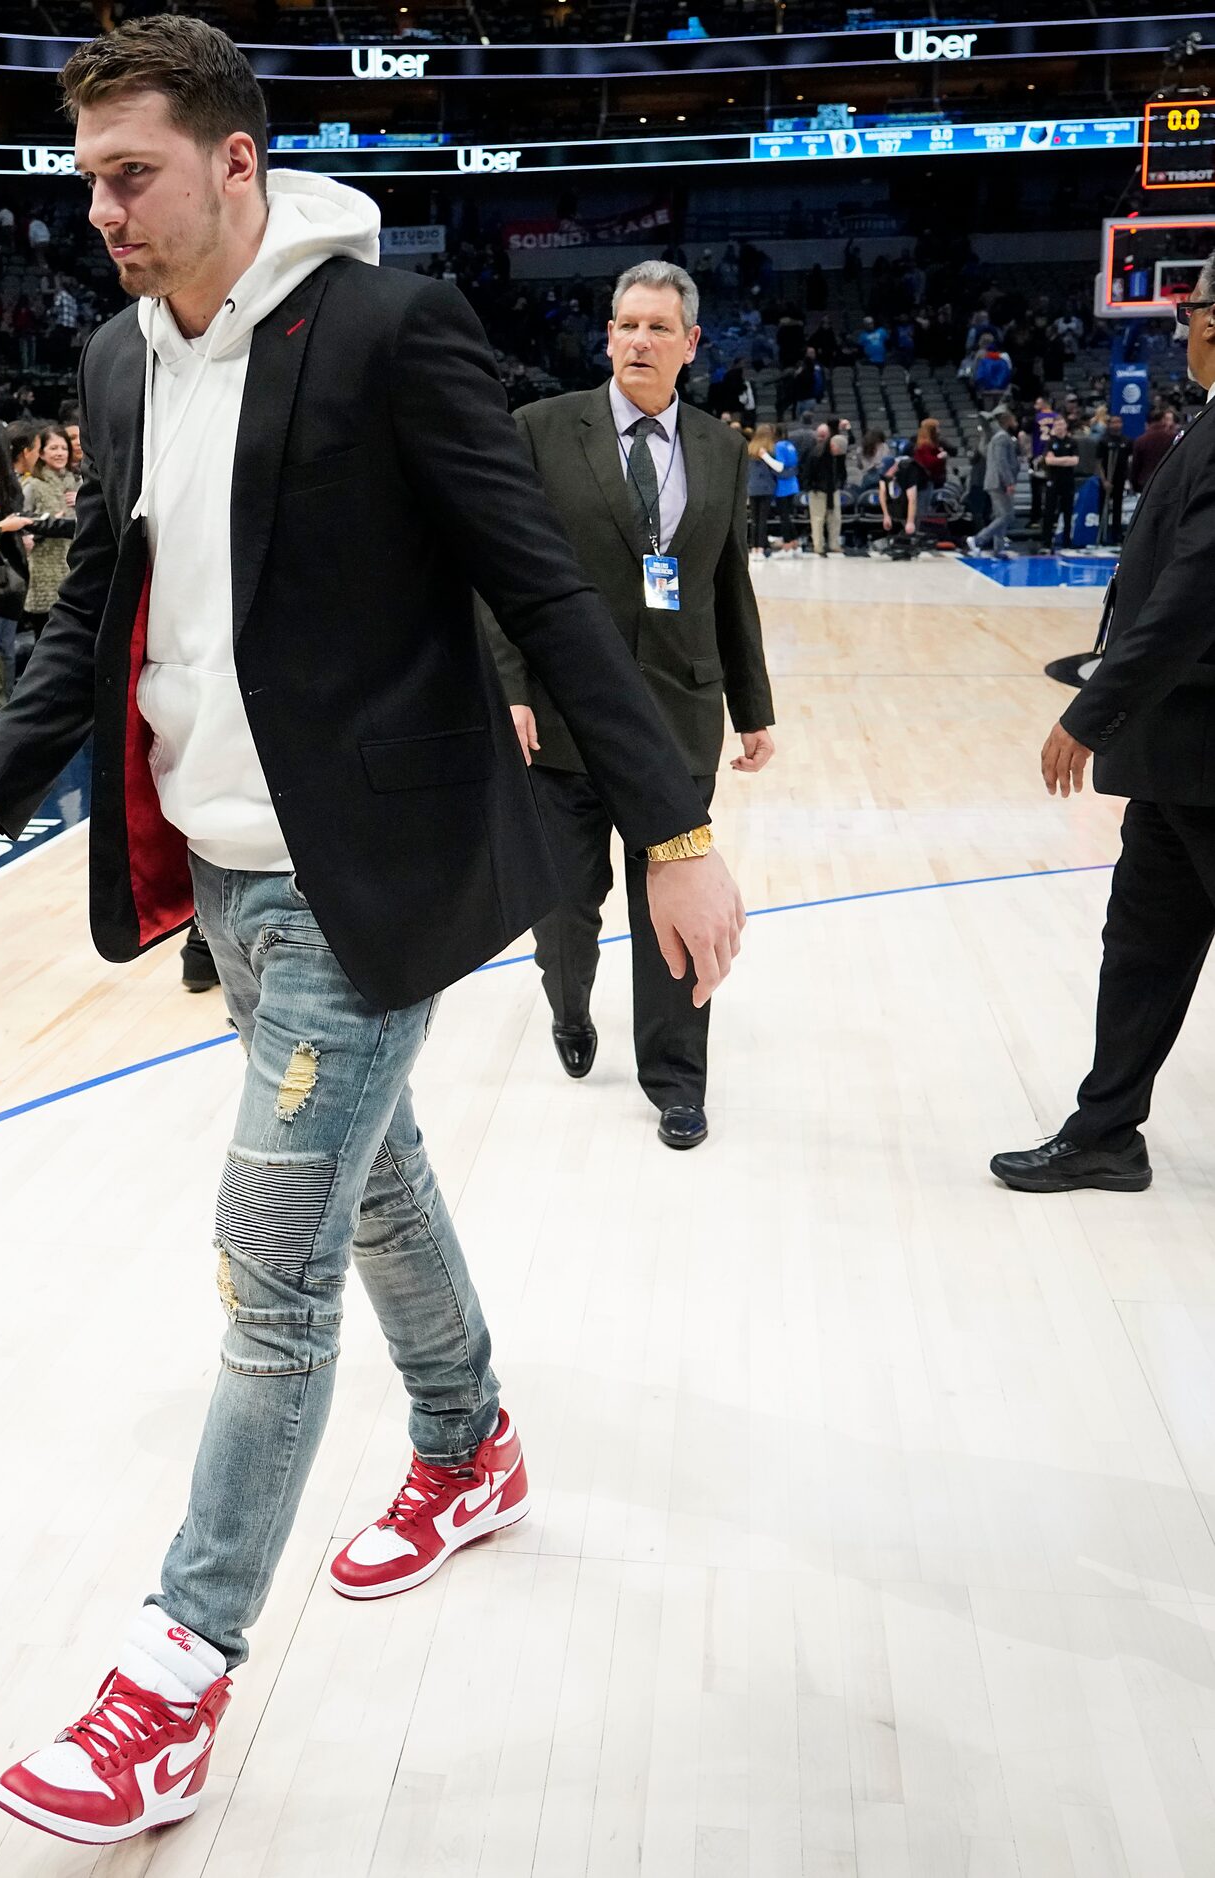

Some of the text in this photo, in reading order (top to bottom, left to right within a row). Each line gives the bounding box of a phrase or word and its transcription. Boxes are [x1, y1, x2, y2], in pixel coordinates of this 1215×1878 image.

[895, 30, 977, 61] Uber
[352, 48, 429, 78] Uber
[1168, 109, 1200, 131] 0.0
[1066, 133, 1076, 144] 4
[22, 147, 75, 174] Ube
[457, 148, 521, 172] Uber
[1167, 169, 1214, 181] TISSOT
[508, 231, 582, 249] SOUND
[175, 1626, 191, 1639] NIKE
[177, 1640, 191, 1652] AIR
